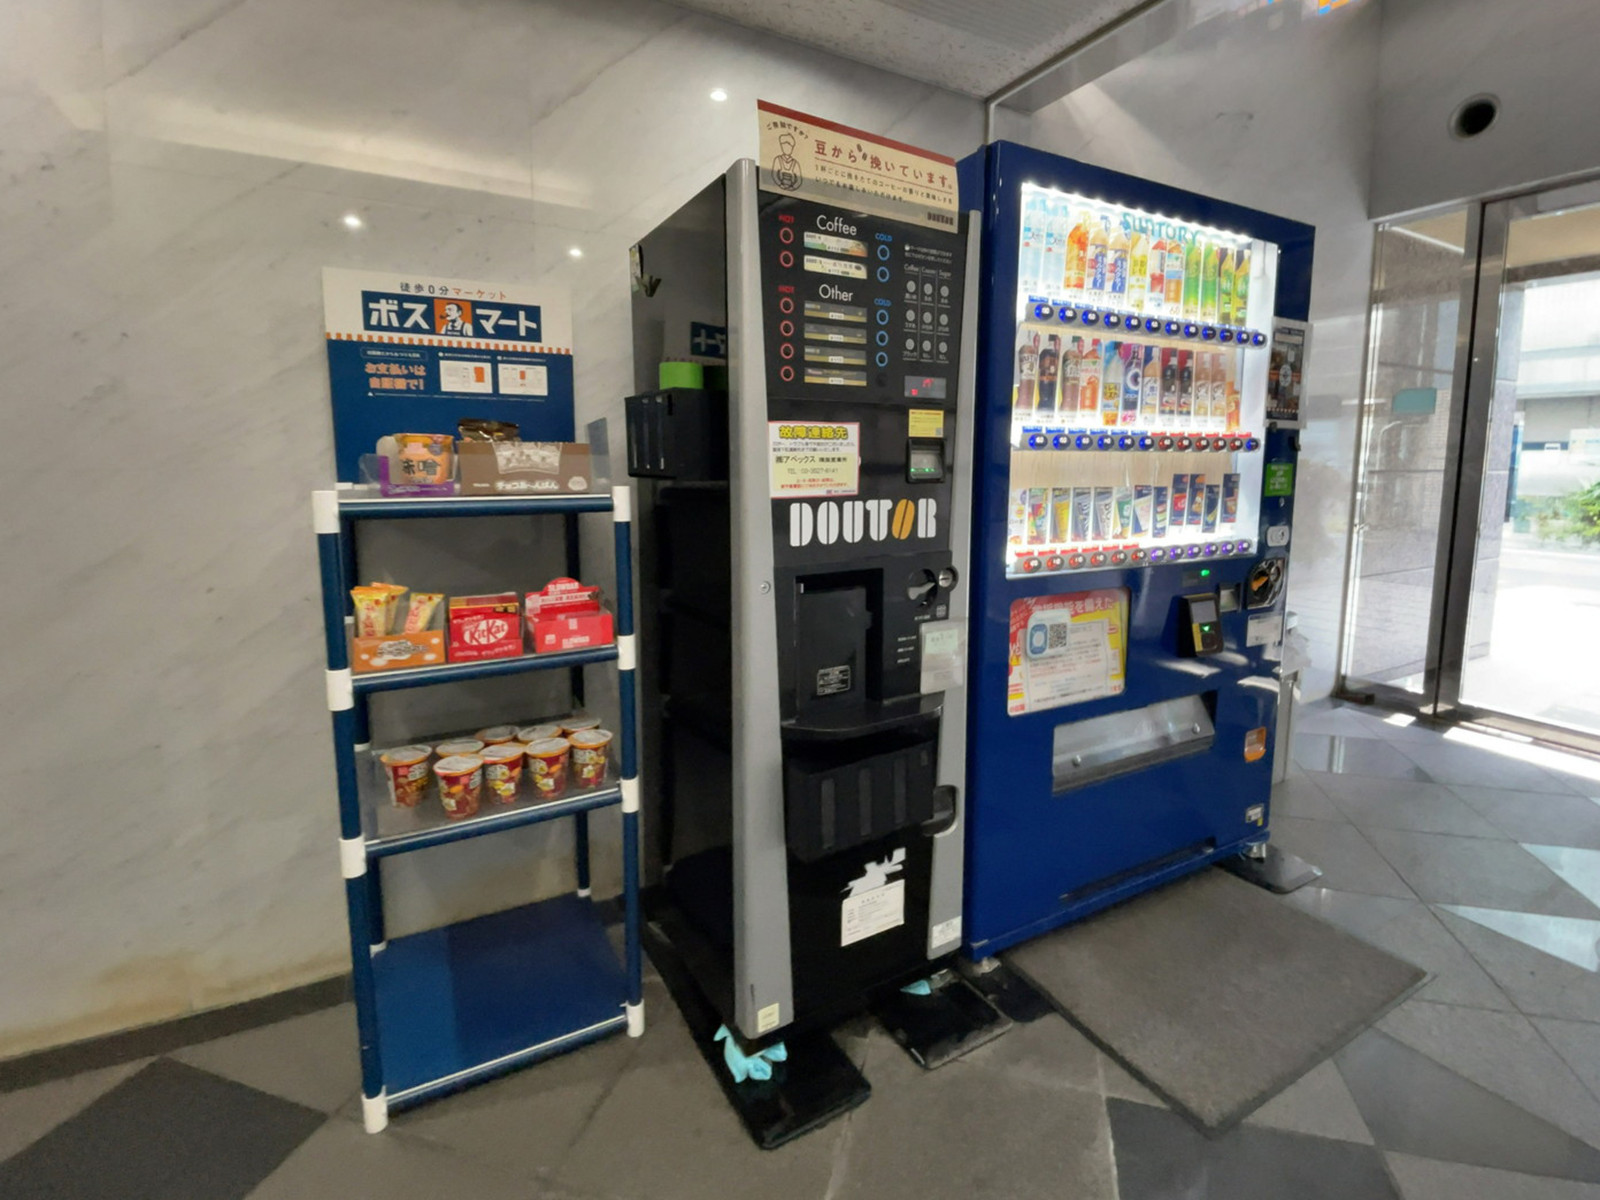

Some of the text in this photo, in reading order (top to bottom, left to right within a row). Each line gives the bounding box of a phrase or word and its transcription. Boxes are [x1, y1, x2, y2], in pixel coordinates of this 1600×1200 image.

[816, 214, 858, 236] Coffee
[1121, 212, 1200, 247] SUNTORY
[818, 283, 854, 301] Other
[368, 298, 537, 337] ボス マート
[779, 425, 848, 440] 故障連絡先
[789, 497, 938, 547] DOUTOR
[468, 618, 507, 646] KitKat
